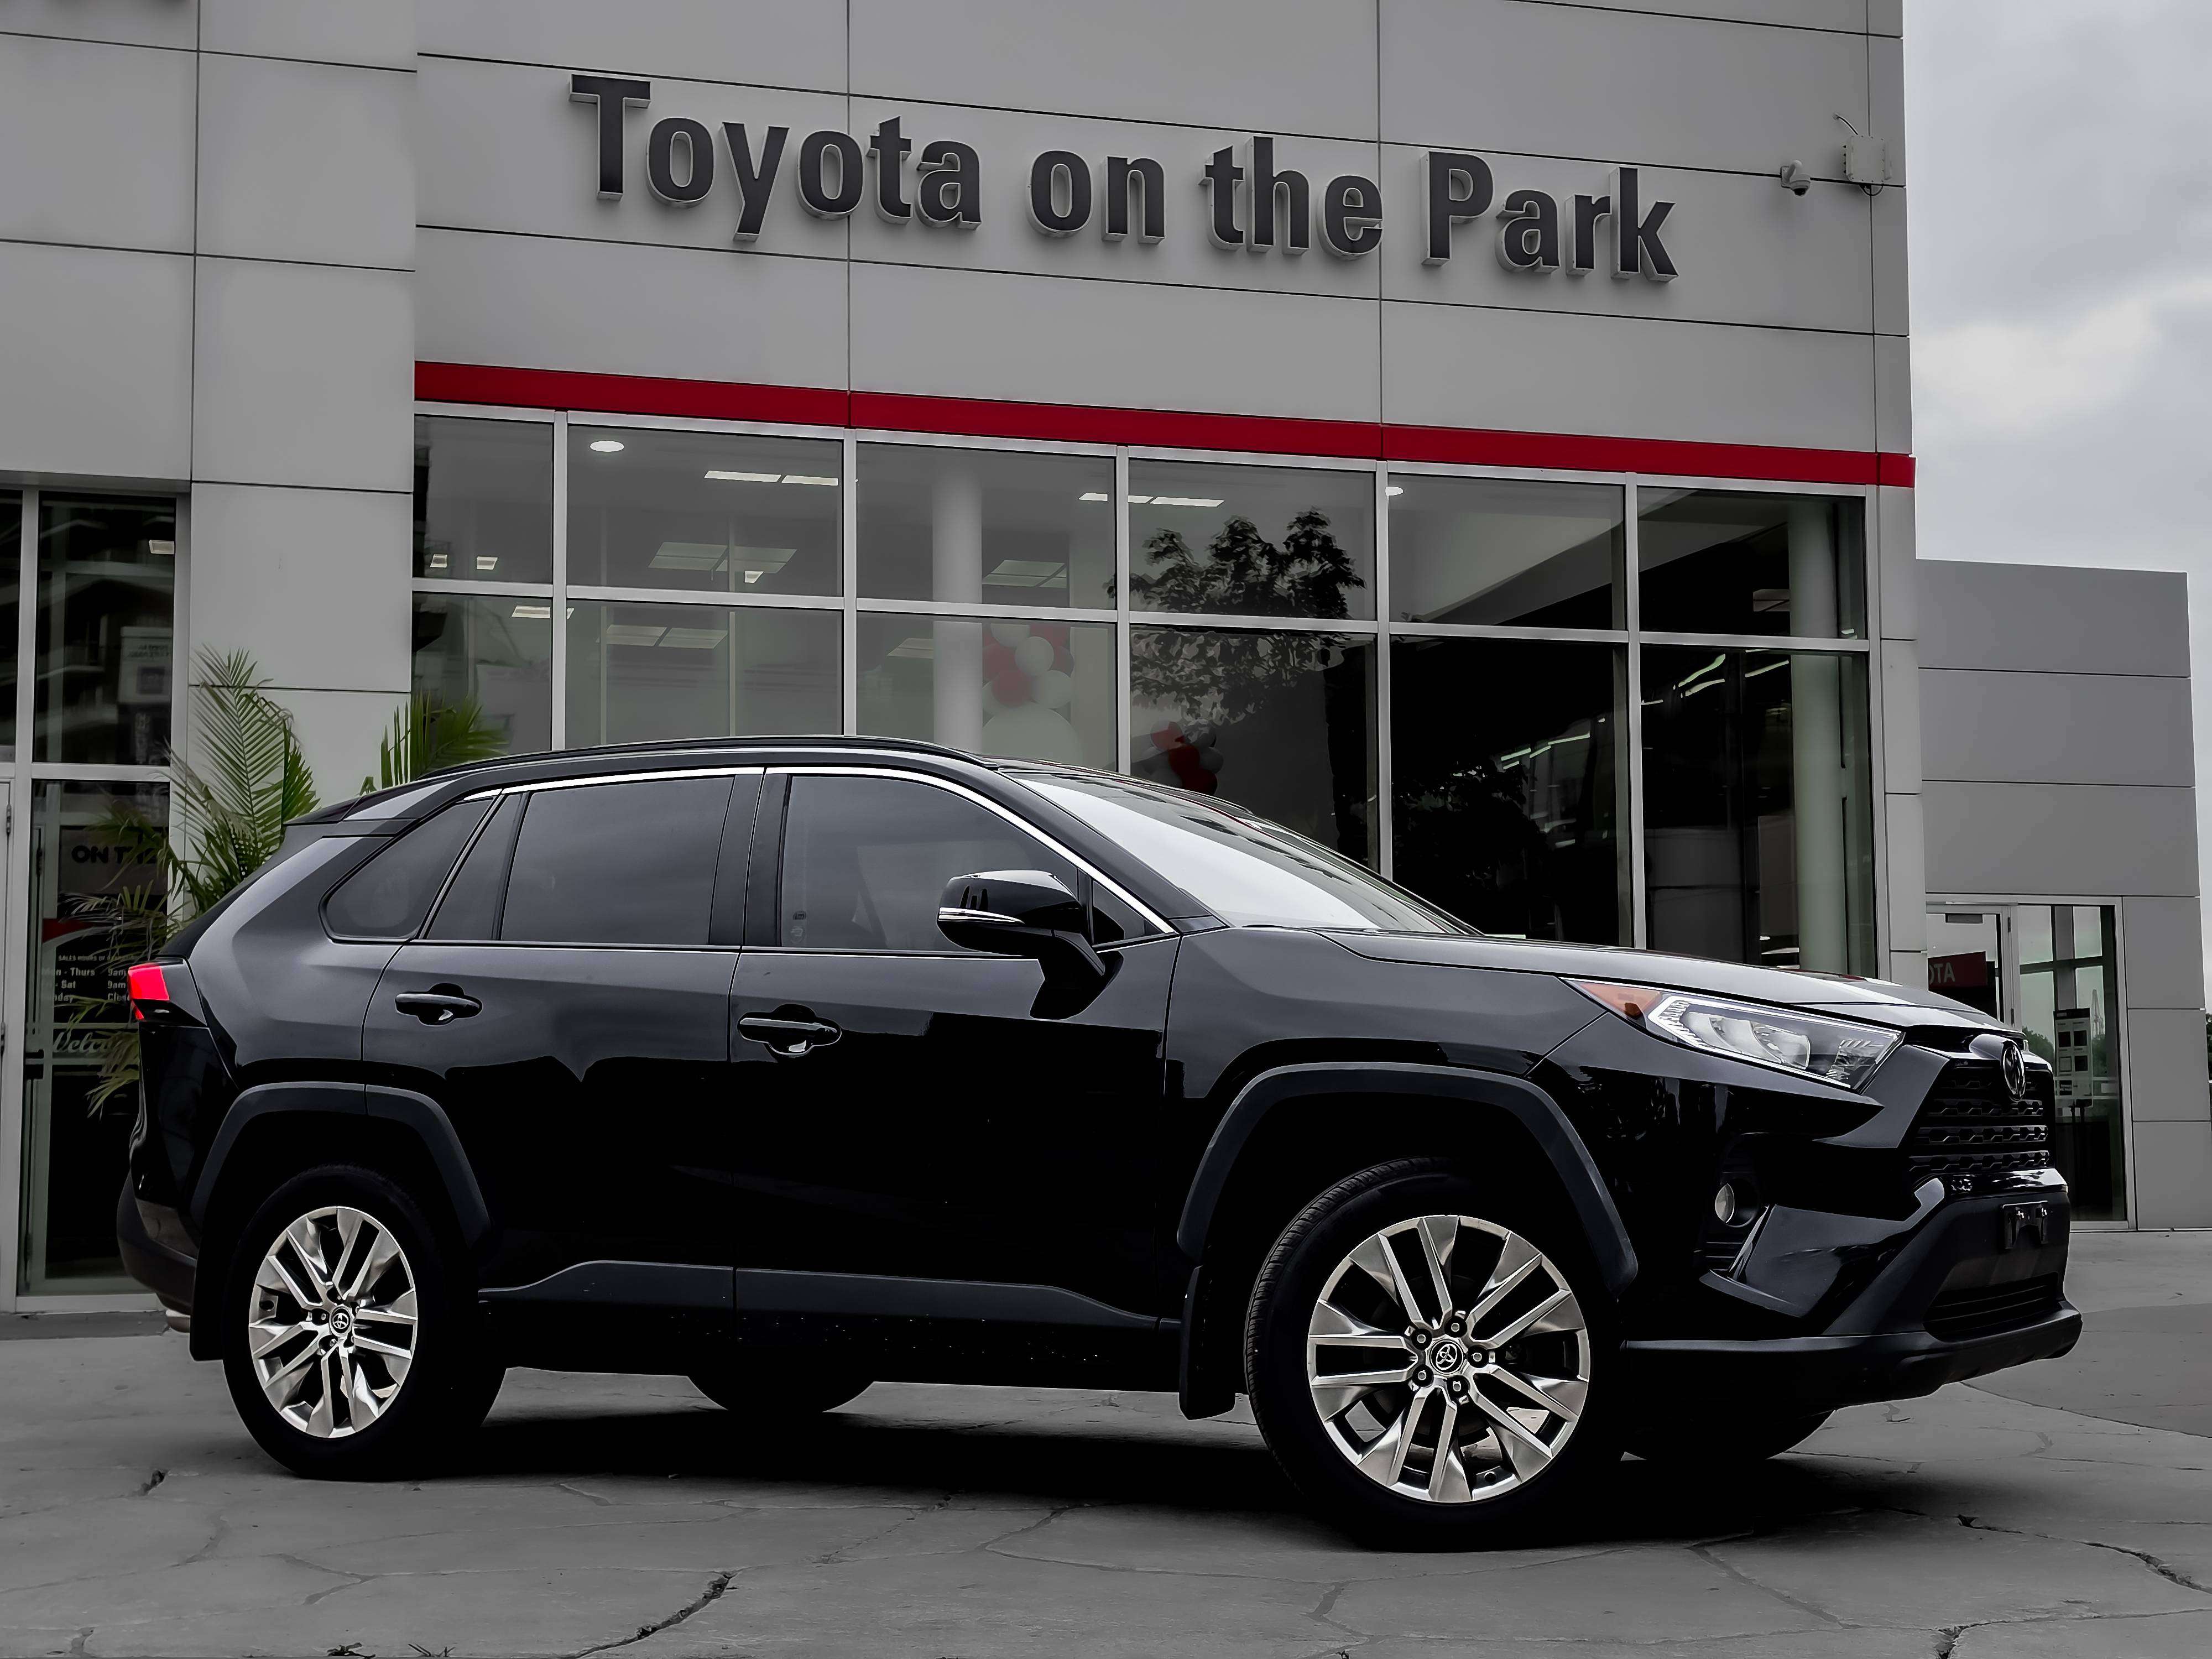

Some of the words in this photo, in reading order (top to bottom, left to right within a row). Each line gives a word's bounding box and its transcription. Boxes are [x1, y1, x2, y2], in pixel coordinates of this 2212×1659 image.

[568, 74, 982, 242] Toyota
[1029, 149, 1165, 244] on
[1198, 136, 1383, 259] the
[1420, 150, 1679, 282] Park
[71, 845, 109, 864] ON
[70, 967, 96, 977] Thurs
